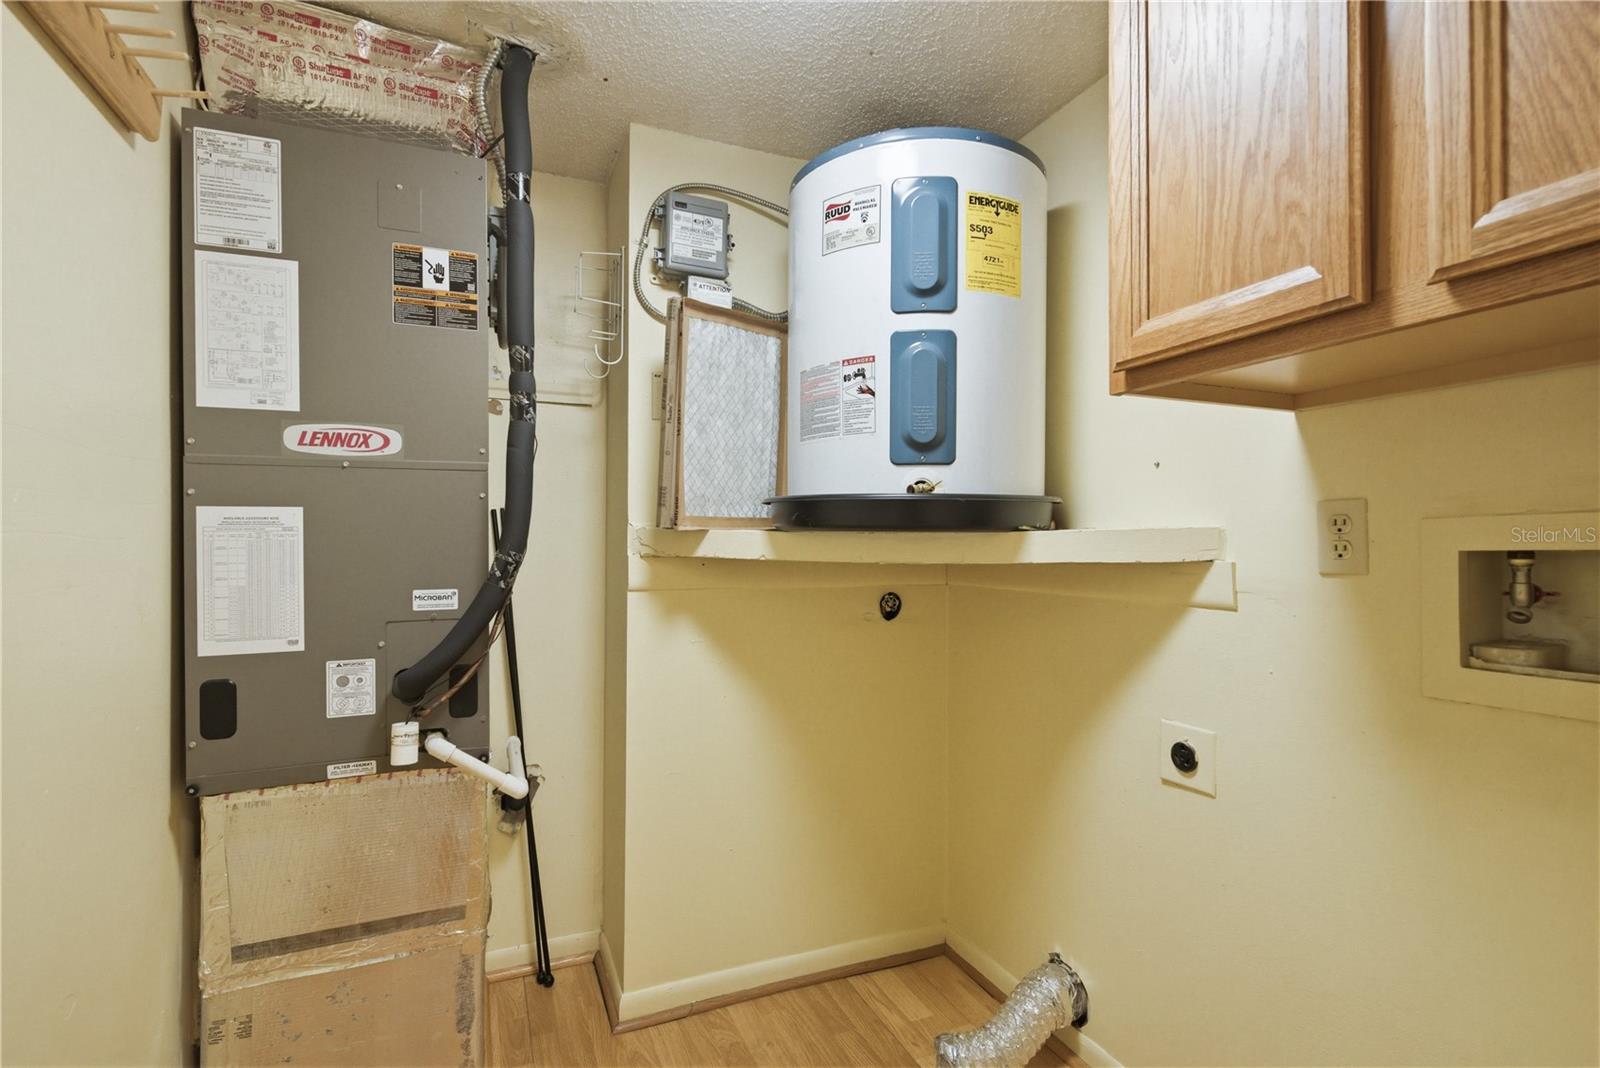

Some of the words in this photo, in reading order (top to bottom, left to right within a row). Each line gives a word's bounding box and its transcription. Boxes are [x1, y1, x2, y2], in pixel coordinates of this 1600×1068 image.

[334, 24, 347, 34] 100
[260, 51, 271, 59] AF
[272, 53, 285, 64] 100
[310, 73, 334, 83] 181A-P
[341, 80, 370, 92] 181B-FX
[365, 75, 377, 85] 100
[824, 204, 851, 221] RUUD
[984, 255, 1000, 264] 4721
[698, 282, 732, 293] ATTENTION
[297, 431, 372, 449] LENNOX
